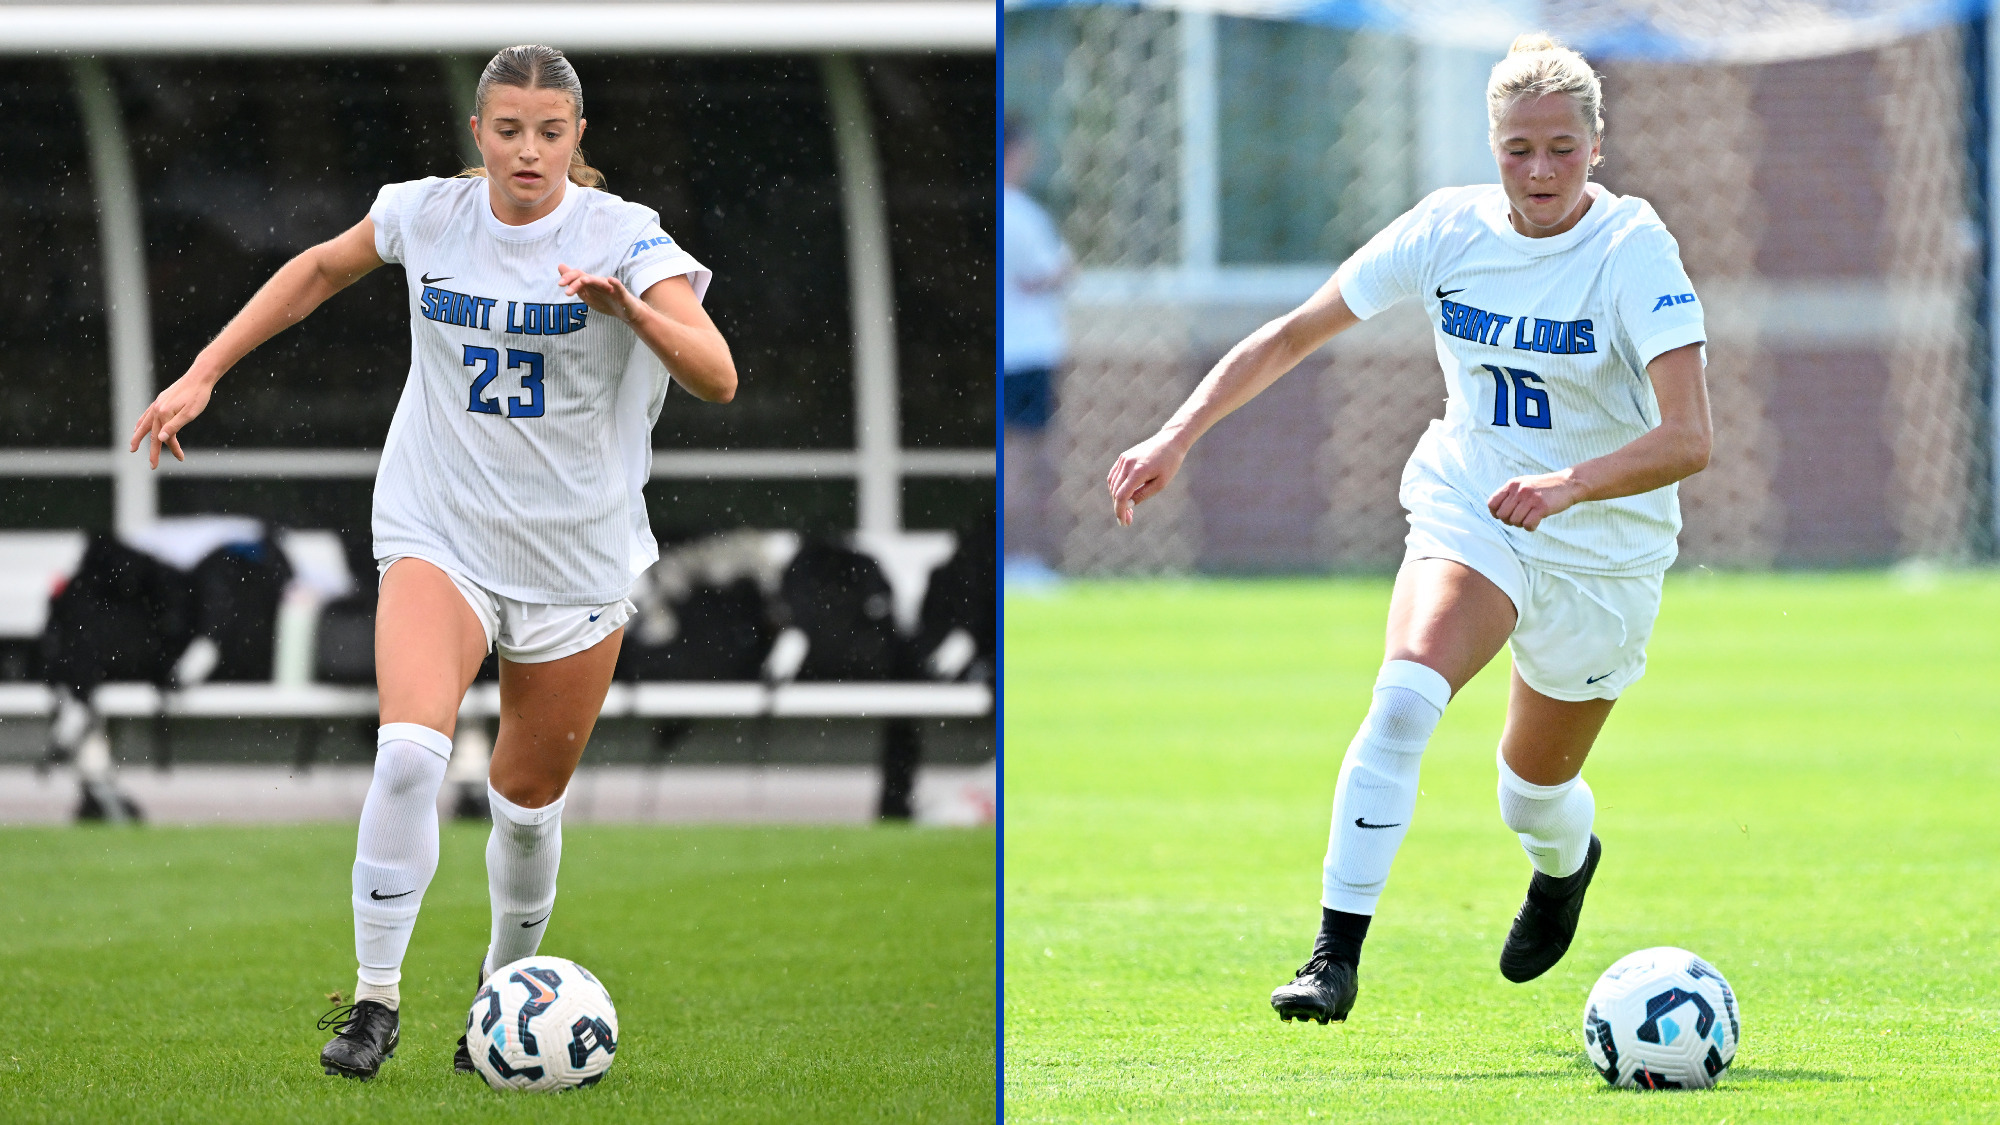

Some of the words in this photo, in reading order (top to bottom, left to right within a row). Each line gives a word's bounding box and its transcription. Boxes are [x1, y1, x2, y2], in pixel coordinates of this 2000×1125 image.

[420, 285, 498, 331] SAINT
[505, 301, 588, 335] LOUIS
[1440, 299, 1513, 346] SAINT
[1513, 316, 1598, 355] LOUIS
[462, 343, 545, 418] 23
[1481, 363, 1552, 430] 16
